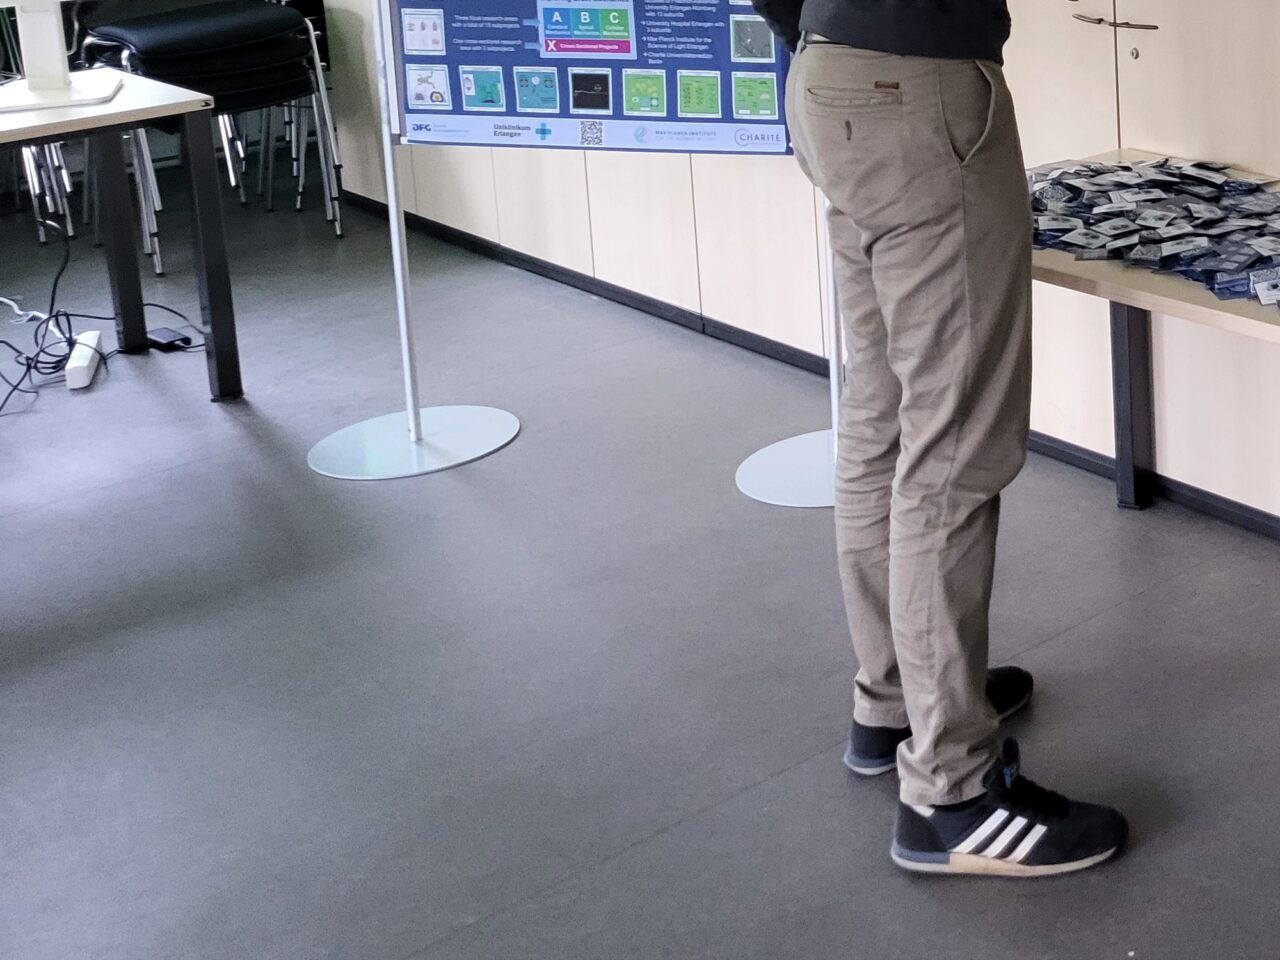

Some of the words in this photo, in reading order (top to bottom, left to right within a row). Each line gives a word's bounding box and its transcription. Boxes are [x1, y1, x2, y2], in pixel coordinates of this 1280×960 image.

[552, 12, 562, 22] A
[580, 12, 590, 23] B
[610, 12, 619, 24] C
[547, 40, 557, 51] X
